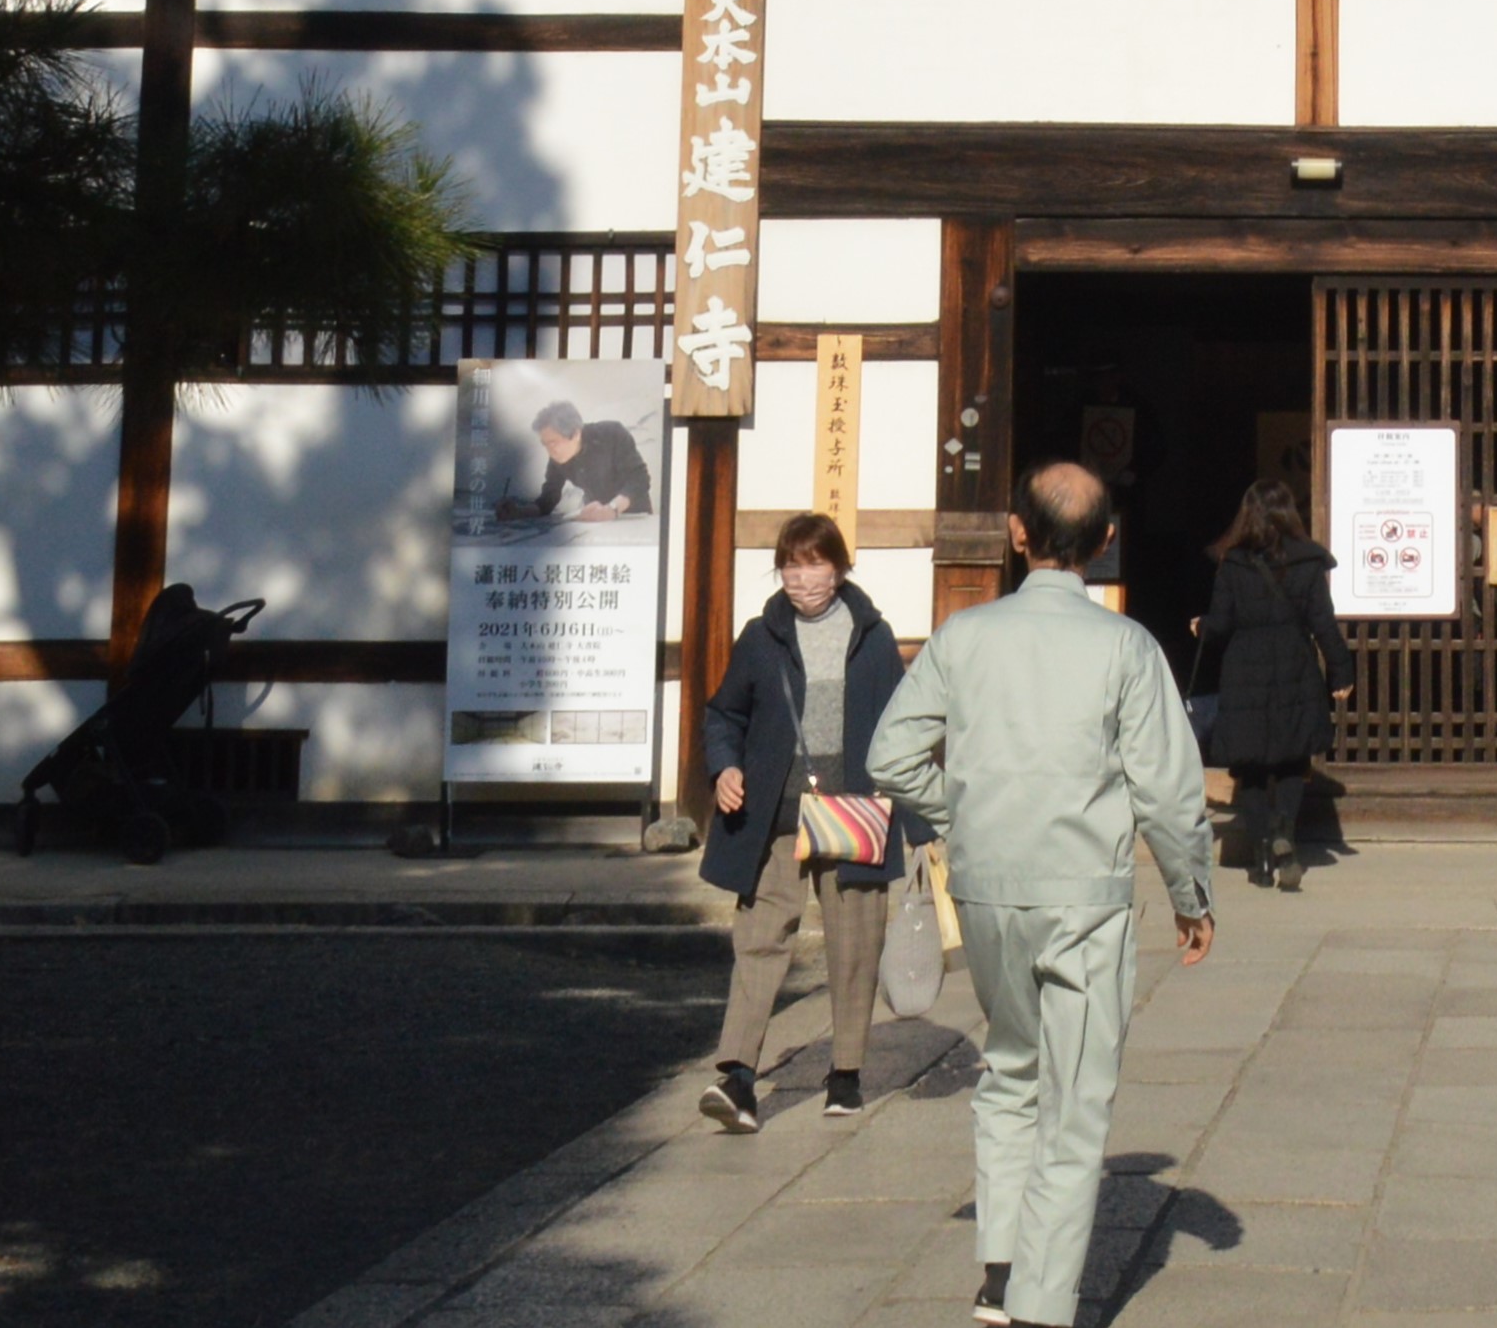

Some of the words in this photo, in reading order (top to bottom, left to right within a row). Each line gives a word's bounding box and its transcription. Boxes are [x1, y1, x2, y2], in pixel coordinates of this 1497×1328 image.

[827, 353, 848, 477] 数珠玉授与所
[474, 563, 631, 584] 瀟湘八景図襖絵
[486, 590, 619, 610] 奉納特別公開
